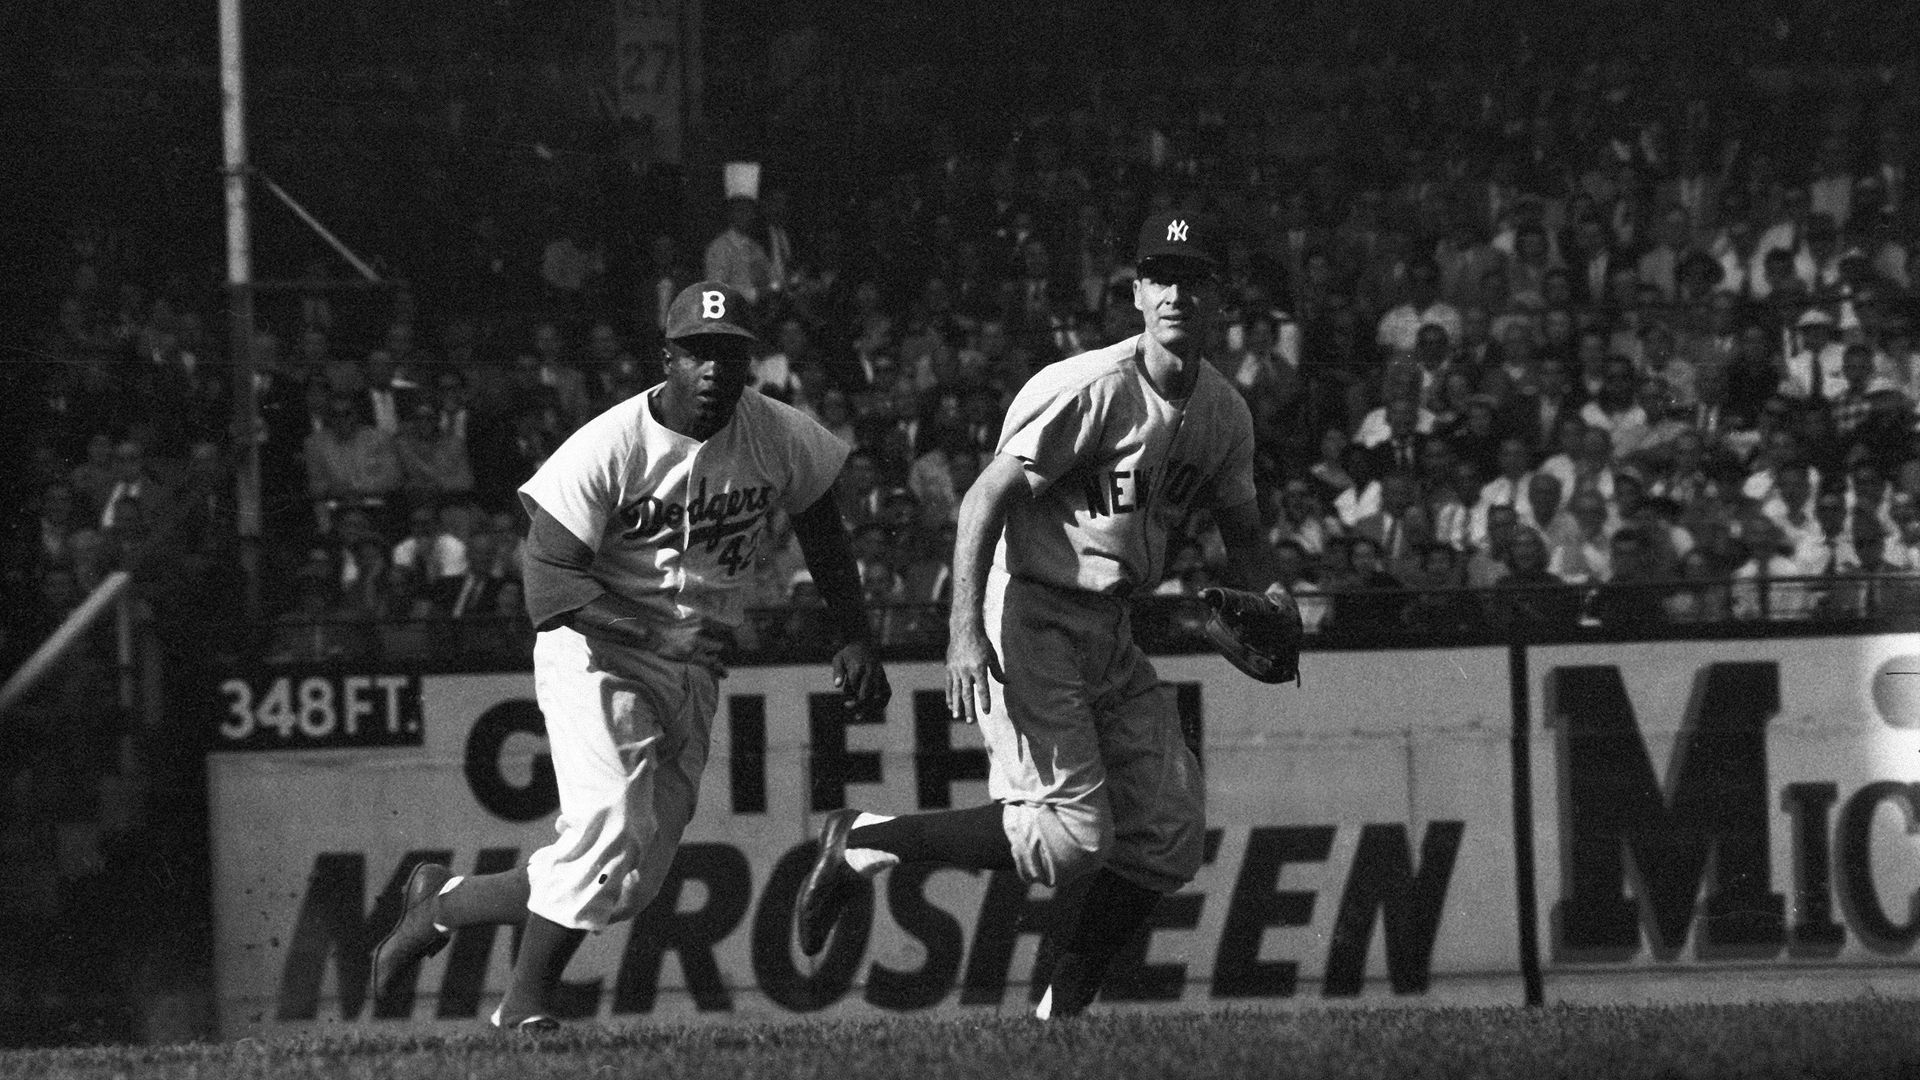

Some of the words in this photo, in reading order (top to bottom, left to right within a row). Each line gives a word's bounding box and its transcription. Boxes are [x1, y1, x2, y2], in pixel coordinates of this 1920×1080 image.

[623, 41, 674, 94] 27
[1167, 219, 1189, 241] NY
[702, 290, 726, 319] B
[620, 477, 772, 554] Dodgers
